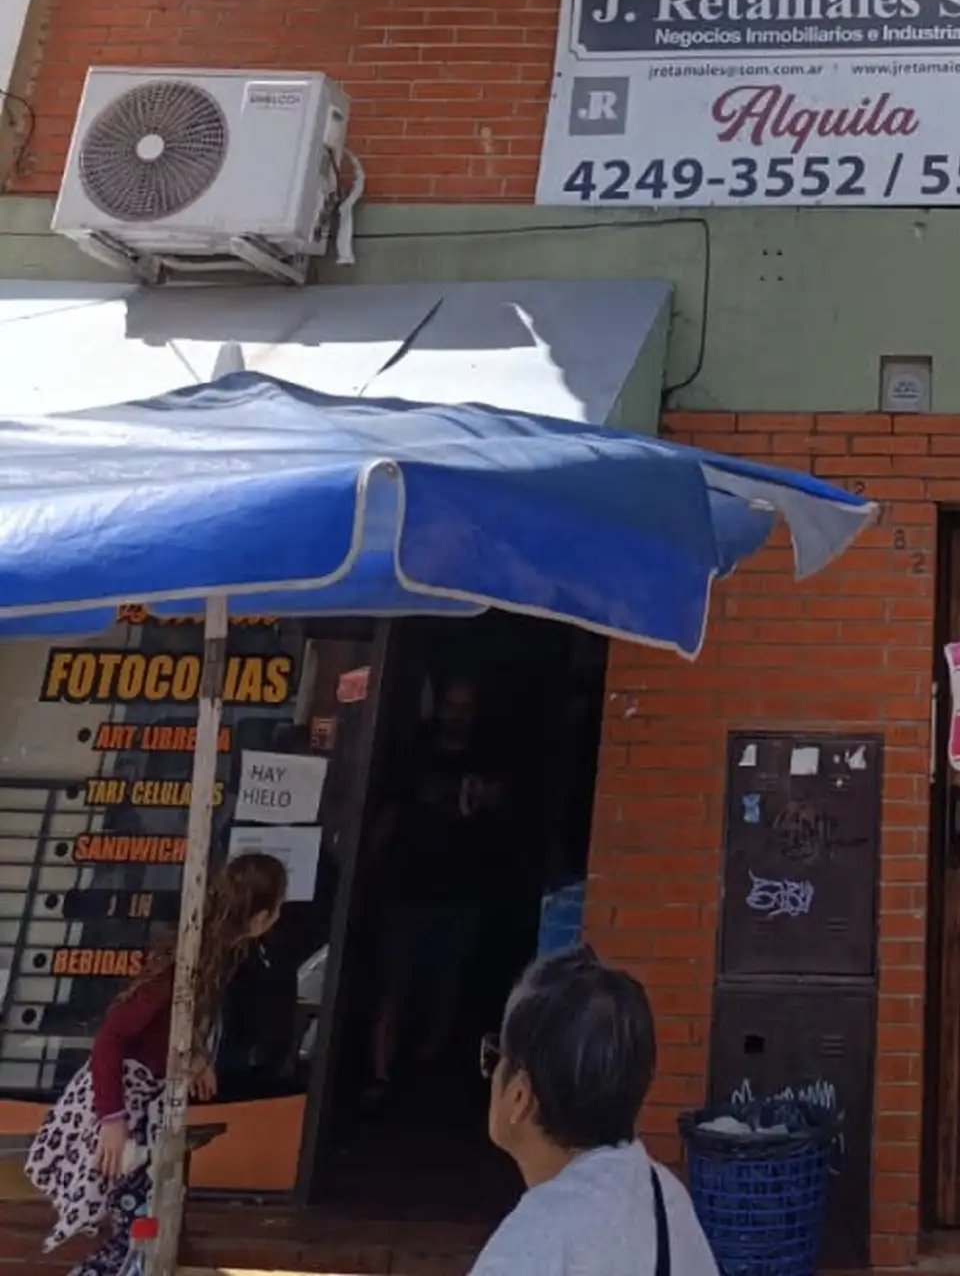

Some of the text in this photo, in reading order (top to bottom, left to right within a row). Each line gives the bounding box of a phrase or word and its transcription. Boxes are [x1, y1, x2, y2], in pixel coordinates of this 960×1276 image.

[655, 27, 741, 47] Negocios
[747, 26, 863, 43] Inmobiliarios
[867, 29, 879, 41] e
[711, 84, 919, 153] Alquila
[563, 156, 866, 200] 4249-3552
[46, 653, 292, 703] FOTOCOIAS
[95, 725, 230, 752] ART LIBREA
[250, 764, 286, 783] HAY
[131, 781, 224, 806] CELULAS
[242, 787, 292, 808] HIELO
[53, 949, 143, 975] BEBIDAS
